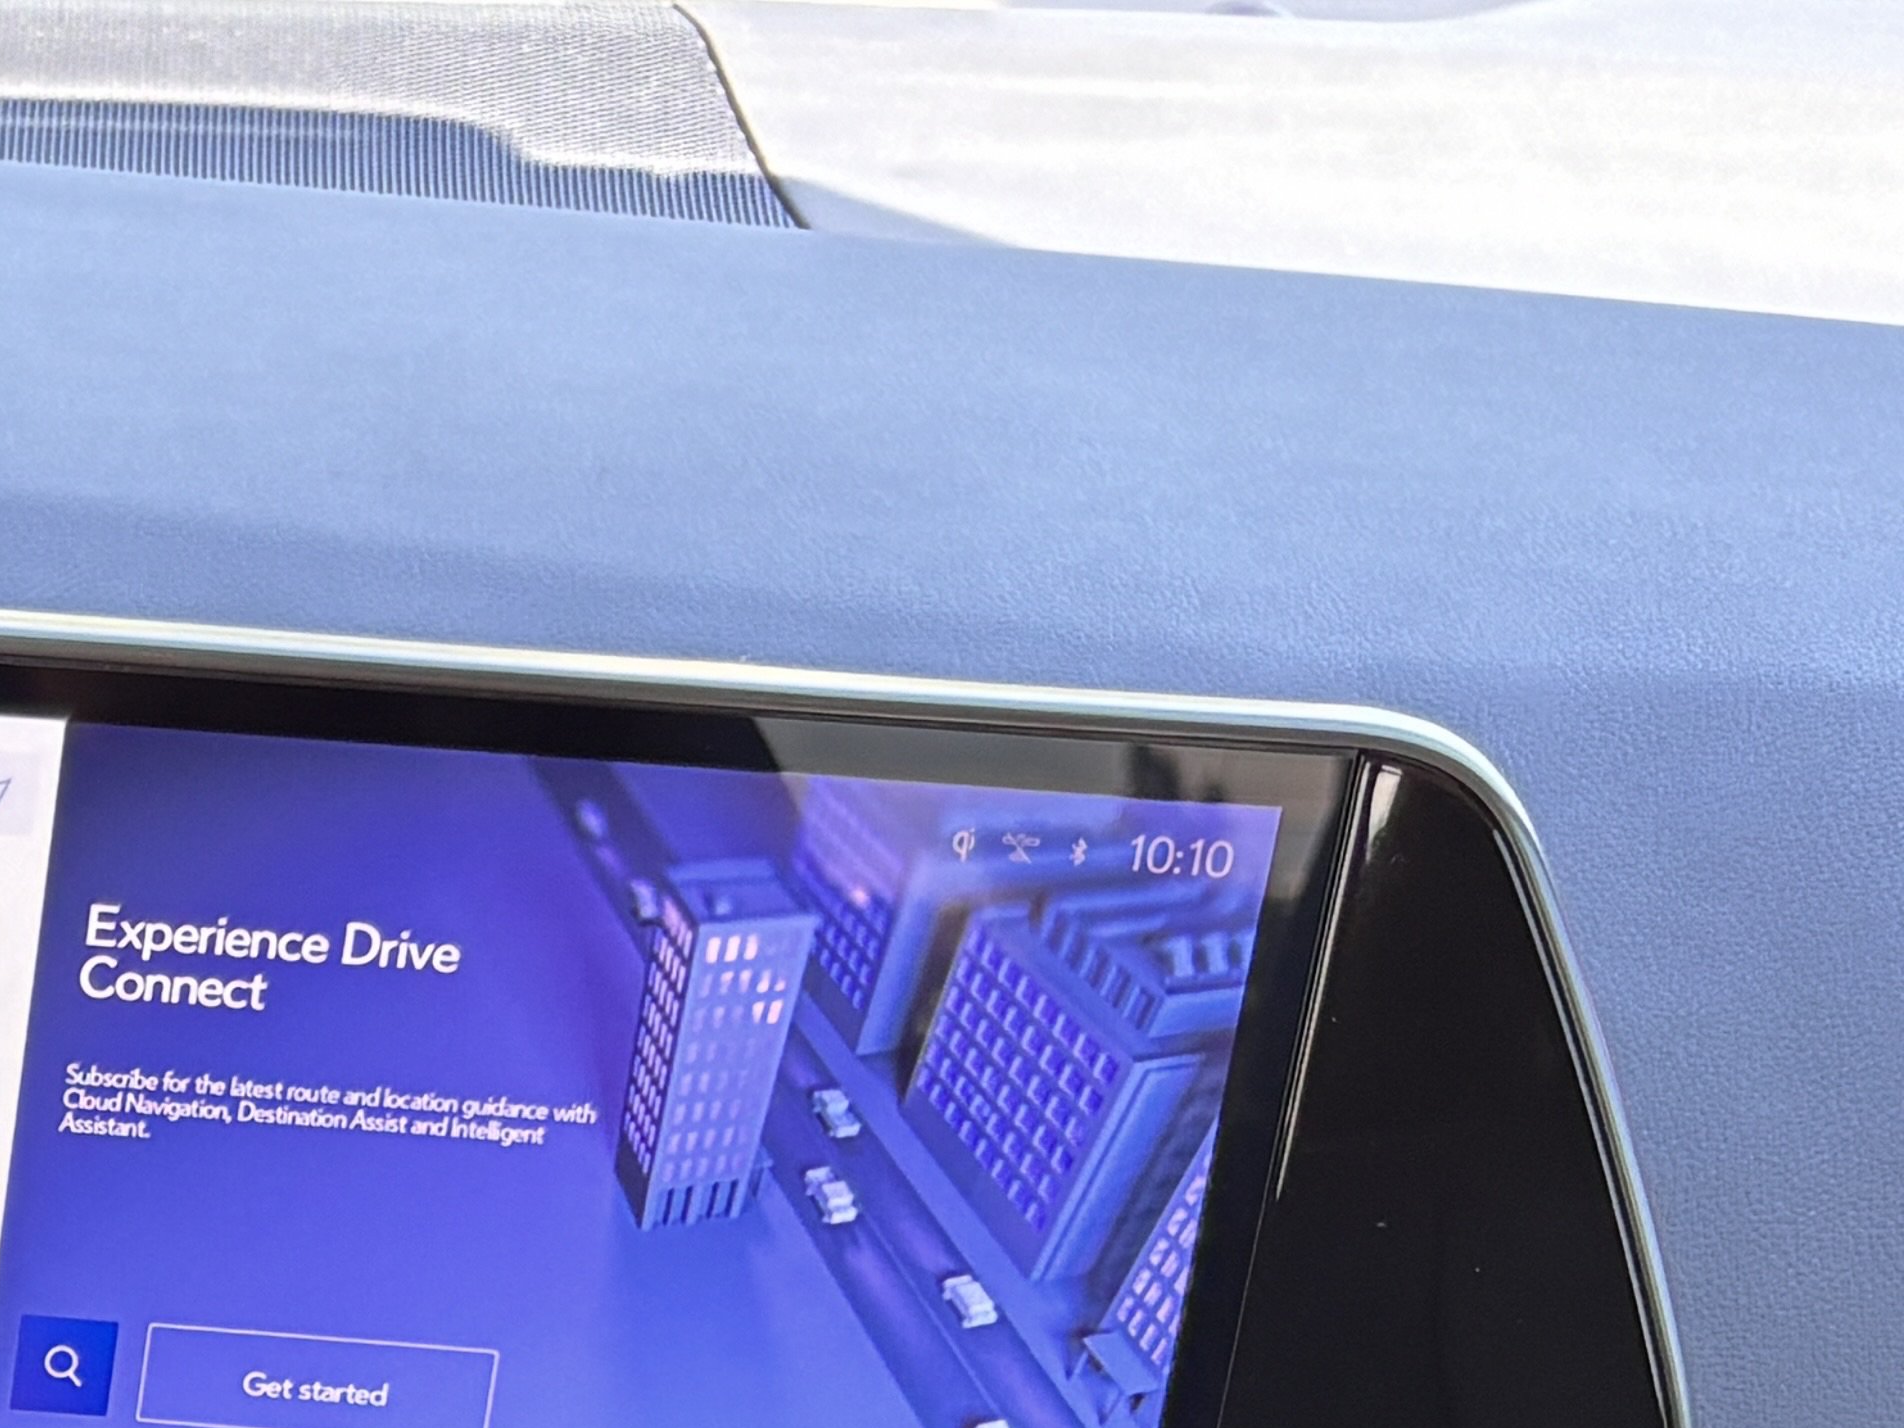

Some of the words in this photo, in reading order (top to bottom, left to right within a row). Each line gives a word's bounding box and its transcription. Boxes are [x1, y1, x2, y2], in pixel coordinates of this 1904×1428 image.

[1130, 833, 1234, 878] 10:10
[85, 902, 329, 964] Experience
[341, 921, 461, 974] Drive
[79, 955, 269, 1011] Connect
[62, 1087, 123, 1113] Cloud
[125, 1092, 233, 1125] Navigation,
[237, 1101, 344, 1129] Destination
[349, 1109, 407, 1134] Assist
[410, 1116, 449, 1137] and
[450, 1120, 545, 1147] Intelligent
[65, 1062, 159, 1091] Subscribe
[162, 1070, 191, 1093] for
[195, 1073, 225, 1096] the
[229, 1075, 283, 1100] latest
[285, 1085, 341, 1104] route
[343, 1086, 382, 1107] and
[383, 1087, 458, 1113] location
[462, 1097, 548, 1121] guidance
[553, 1103, 597, 1124] with
[58, 1111, 151, 1138] Assistant.
[242, 1370, 292, 1401] Get
[298, 1378, 389, 1408] started
